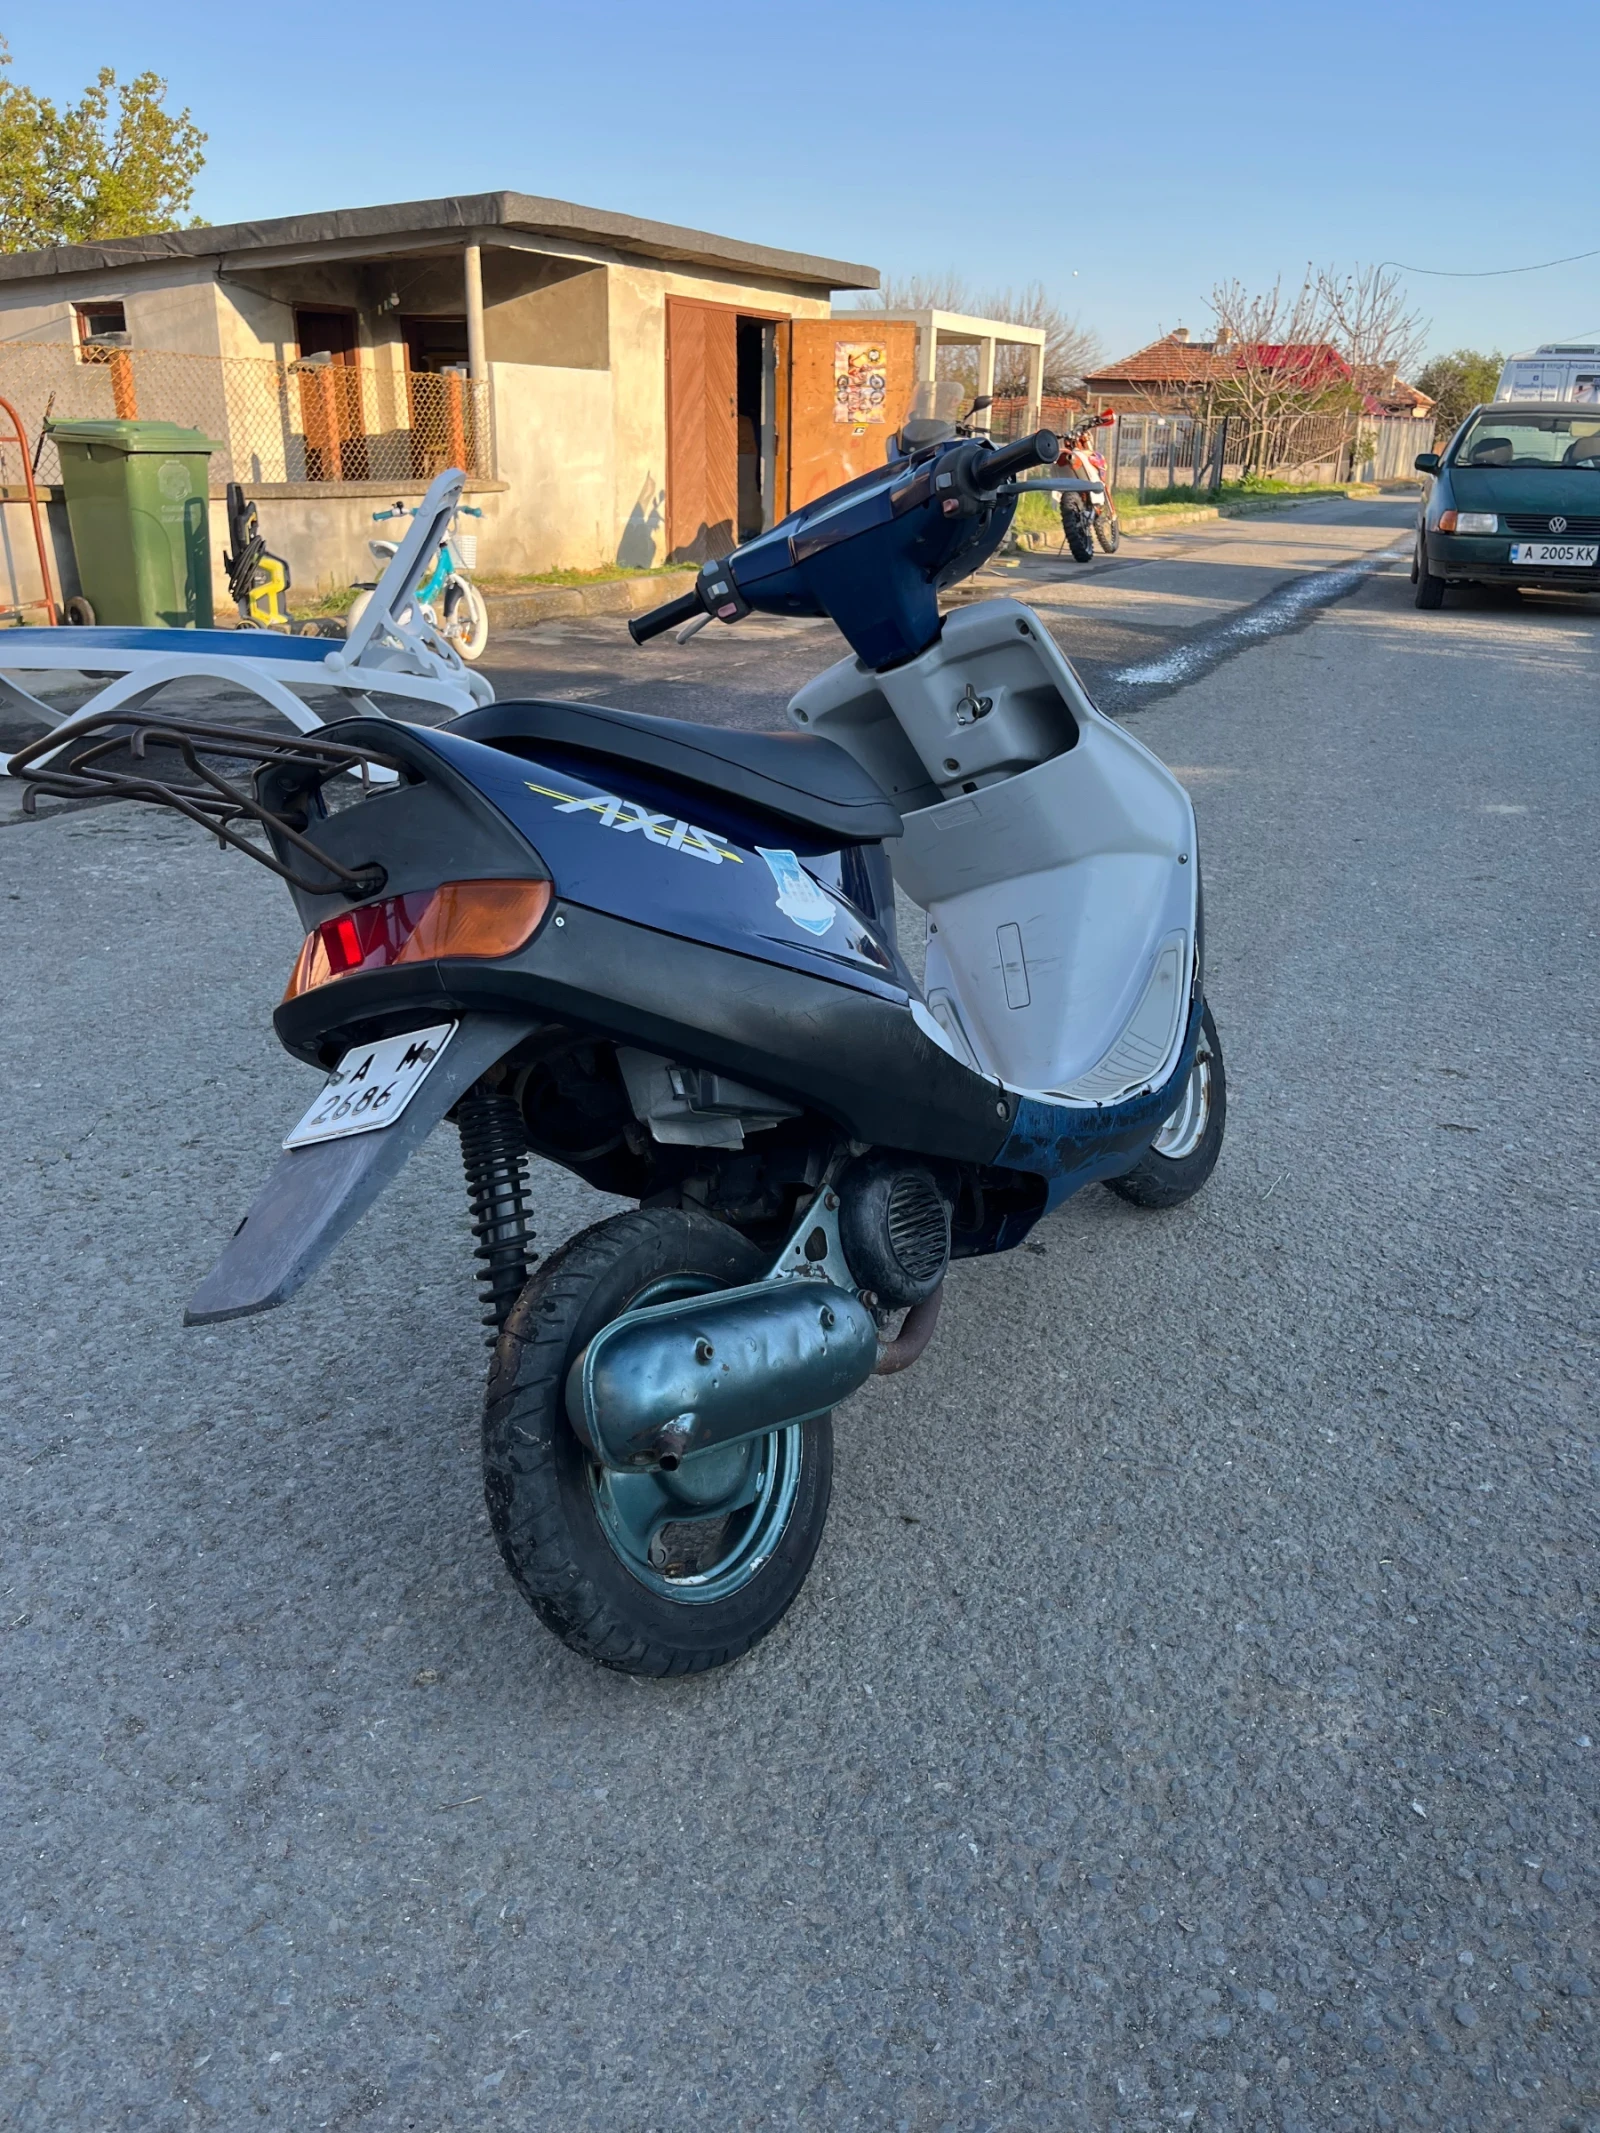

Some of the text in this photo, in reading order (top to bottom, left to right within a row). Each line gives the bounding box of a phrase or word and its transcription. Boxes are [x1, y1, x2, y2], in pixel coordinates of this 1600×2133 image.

[1524, 546, 1596, 561] A 2005 KK
[553, 795, 728, 865] AXIS
[348, 1053, 376, 1085] A
[310, 1081, 397, 1126] 2686
